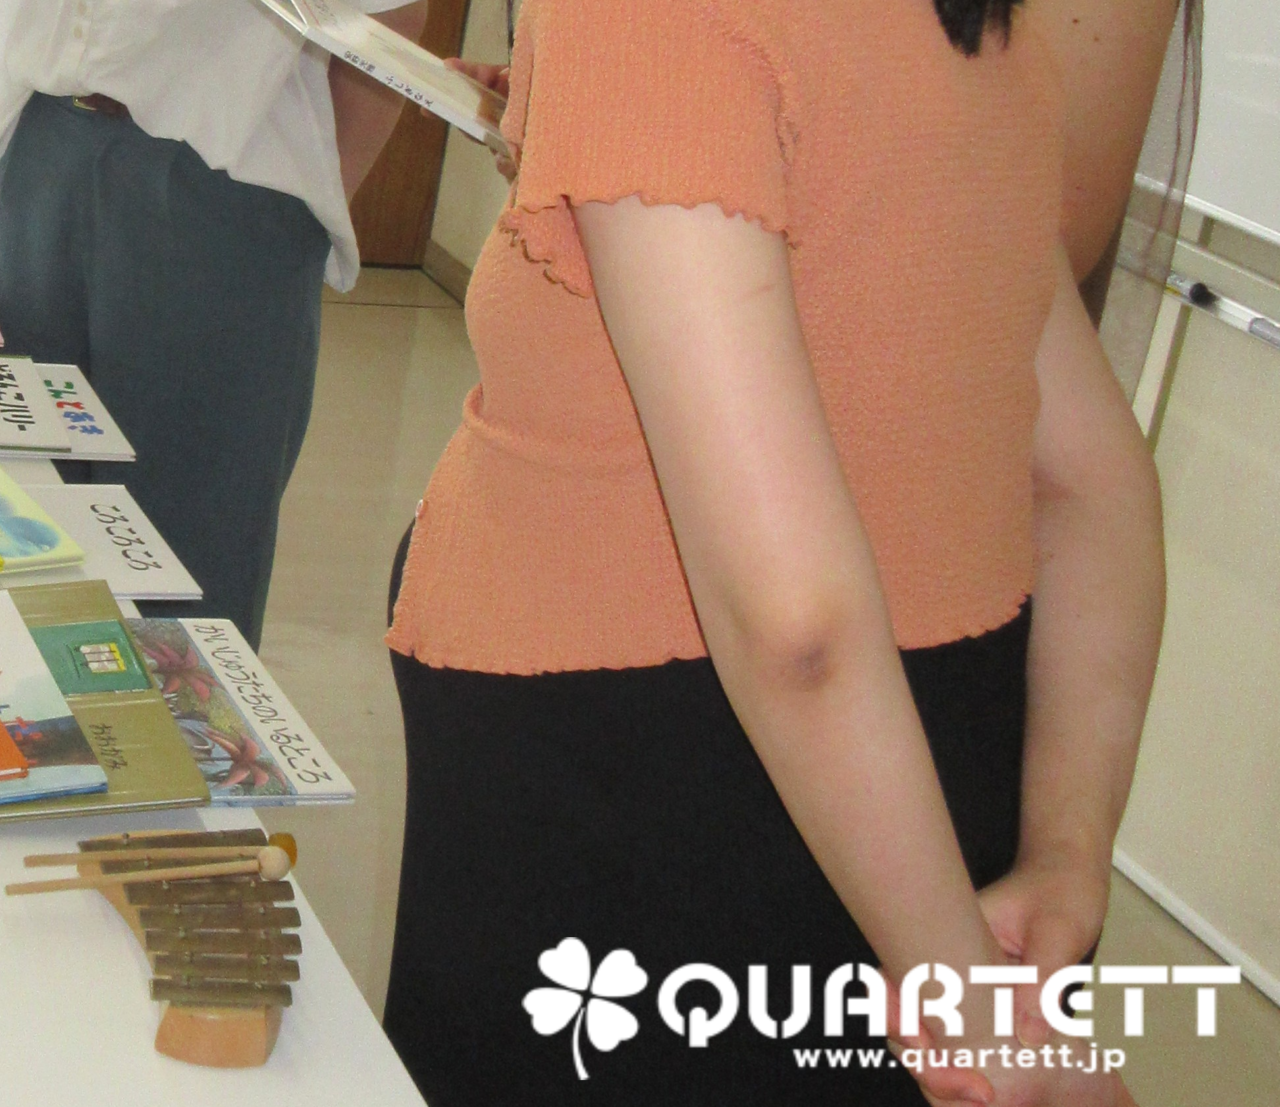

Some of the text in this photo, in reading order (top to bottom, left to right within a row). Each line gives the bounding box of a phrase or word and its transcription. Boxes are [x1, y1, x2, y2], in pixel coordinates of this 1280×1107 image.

[43, 378, 105, 435] こんとあき
[89, 503, 163, 571] ころころころ
[193, 624, 333, 785] かいじゅうたちのいるところ
